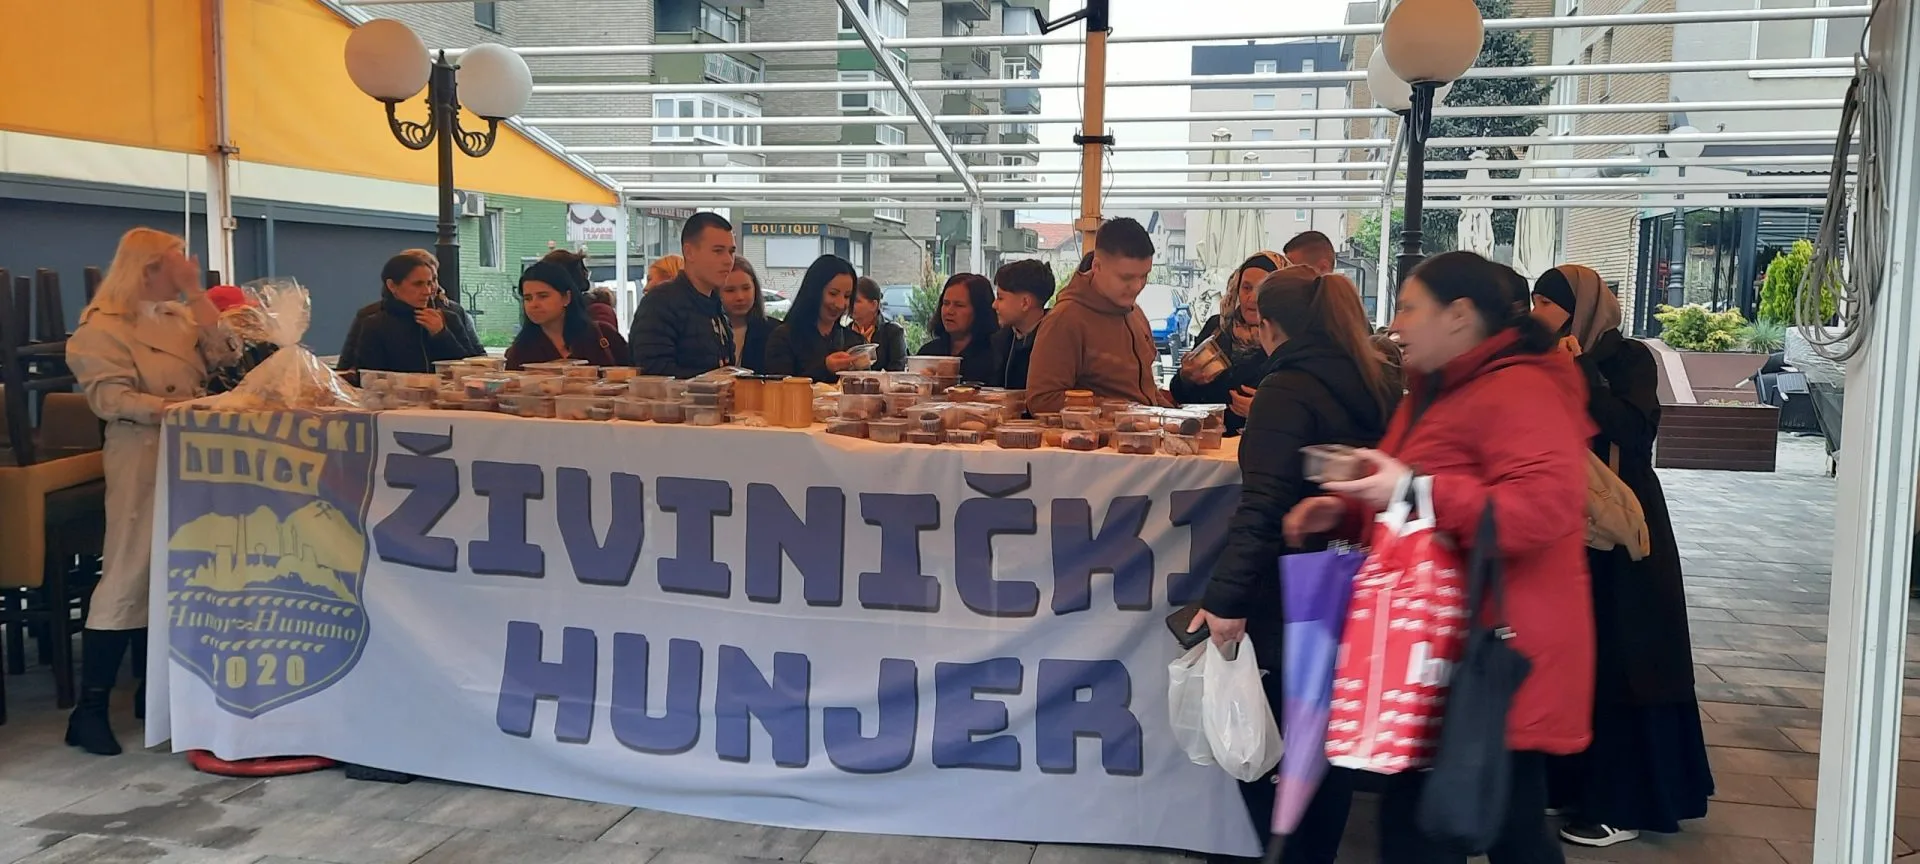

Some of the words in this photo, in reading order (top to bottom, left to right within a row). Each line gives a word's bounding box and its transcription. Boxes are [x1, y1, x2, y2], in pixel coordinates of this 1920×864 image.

[751, 224, 819, 235] BOUTIQUE
[372, 424, 1243, 617] ŽIVINIČKI
[496, 620, 1144, 778] HUNJER
